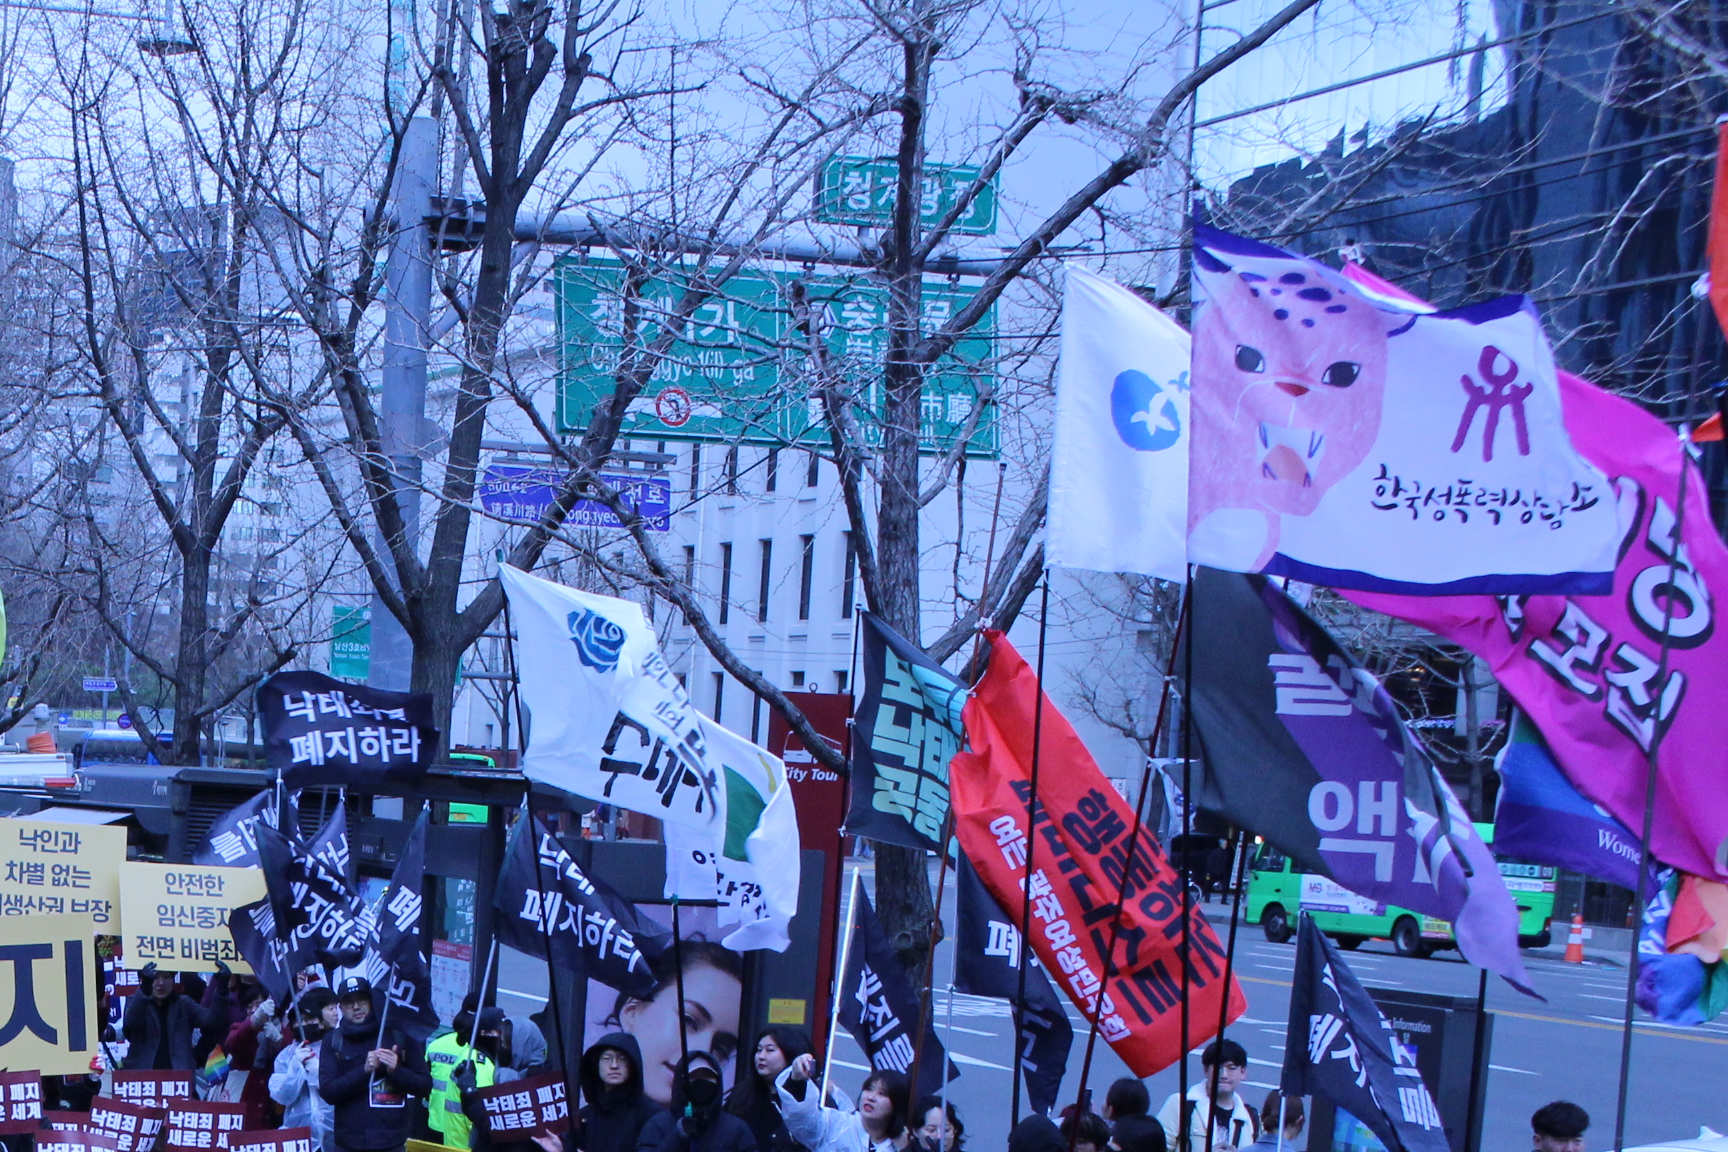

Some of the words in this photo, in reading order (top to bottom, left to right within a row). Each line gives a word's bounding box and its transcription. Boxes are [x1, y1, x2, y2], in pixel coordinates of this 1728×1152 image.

[1371, 463, 1599, 530] 한국성폭력상담소
[289, 726, 421, 766] 폐지하라
[18, 827, 81, 854] 낙인과
[1598, 828, 1642, 865] Wome
[4, 859, 44, 885] 차별
[51, 862, 91, 887] 없는
[164, 871, 225, 899] 안전한
[519, 888, 642, 974] 폐지하라
[136, 935, 172, 960] 전면
[177, 937, 245, 963] 비범죄
